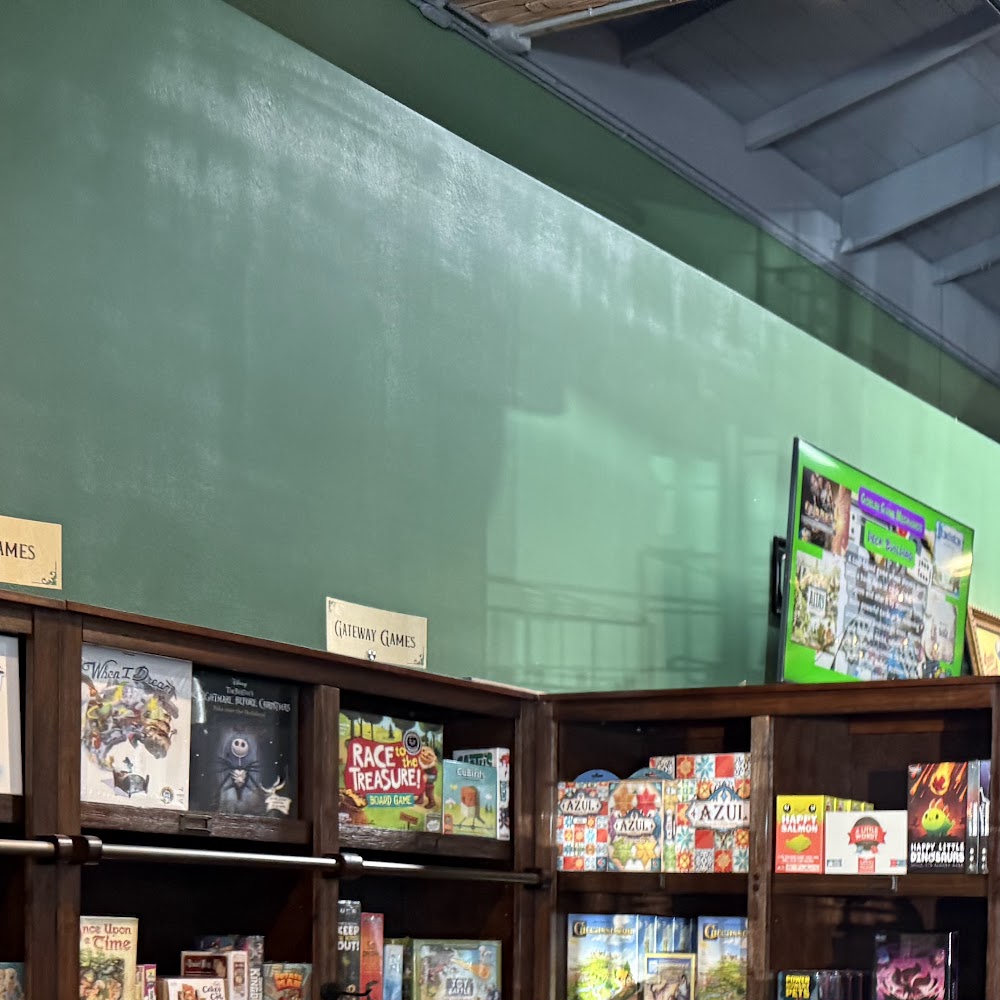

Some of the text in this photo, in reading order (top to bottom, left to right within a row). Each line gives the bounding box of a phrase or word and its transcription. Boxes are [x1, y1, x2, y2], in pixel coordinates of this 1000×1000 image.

[334, 619, 417, 649] GATEWAY GAMES
[83, 660, 120, 679] When
[352, 743, 407, 768] RACE to
[402, 756, 418, 768] the
[349, 767, 422, 791] TREASURE!
[369, 795, 412, 806] BOARD GAME
[565, 799, 595, 812] AZUL
[699, 804, 748, 822] AZUL
[781, 814, 818, 825] HAPPY
[620, 820, 649, 832] AZUL
[781, 824, 818, 834] SALMON
[910, 841, 965, 852] HAPPY LITTLE
[910, 851, 965, 863] DINOSAURS
[82, 923, 132, 937] nce Upon
[92, 935, 132, 951] Time
